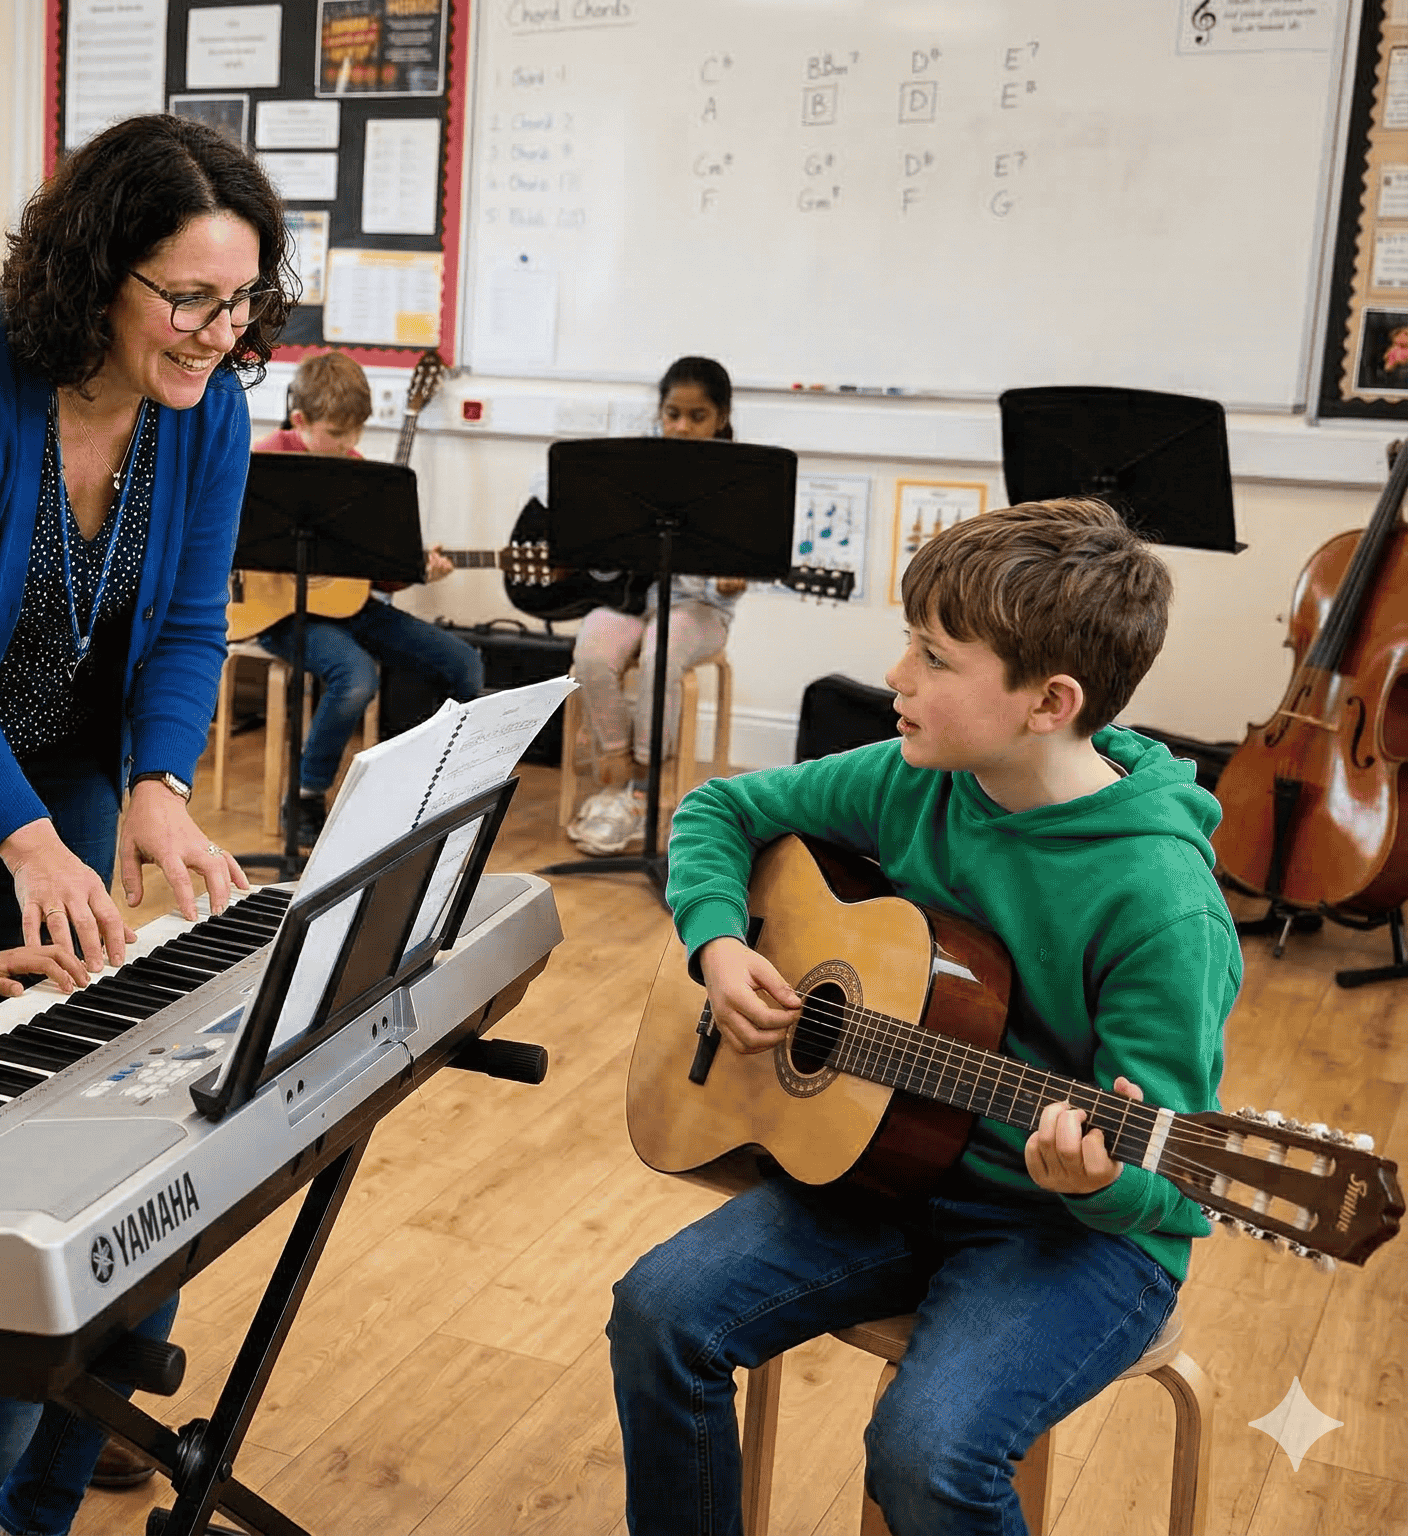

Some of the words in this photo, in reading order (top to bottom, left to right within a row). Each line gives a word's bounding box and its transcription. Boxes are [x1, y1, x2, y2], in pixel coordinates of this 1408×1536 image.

[506, 0, 560, 27] Chord
[700, 96, 718, 122] A
[811, 92, 826, 116] B
[909, 89, 928, 112] D
[701, 187, 720, 213] F
[902, 187, 920, 216] F
[990, 189, 1014, 217] G
[112, 1171, 200, 1267] YAMAHA
